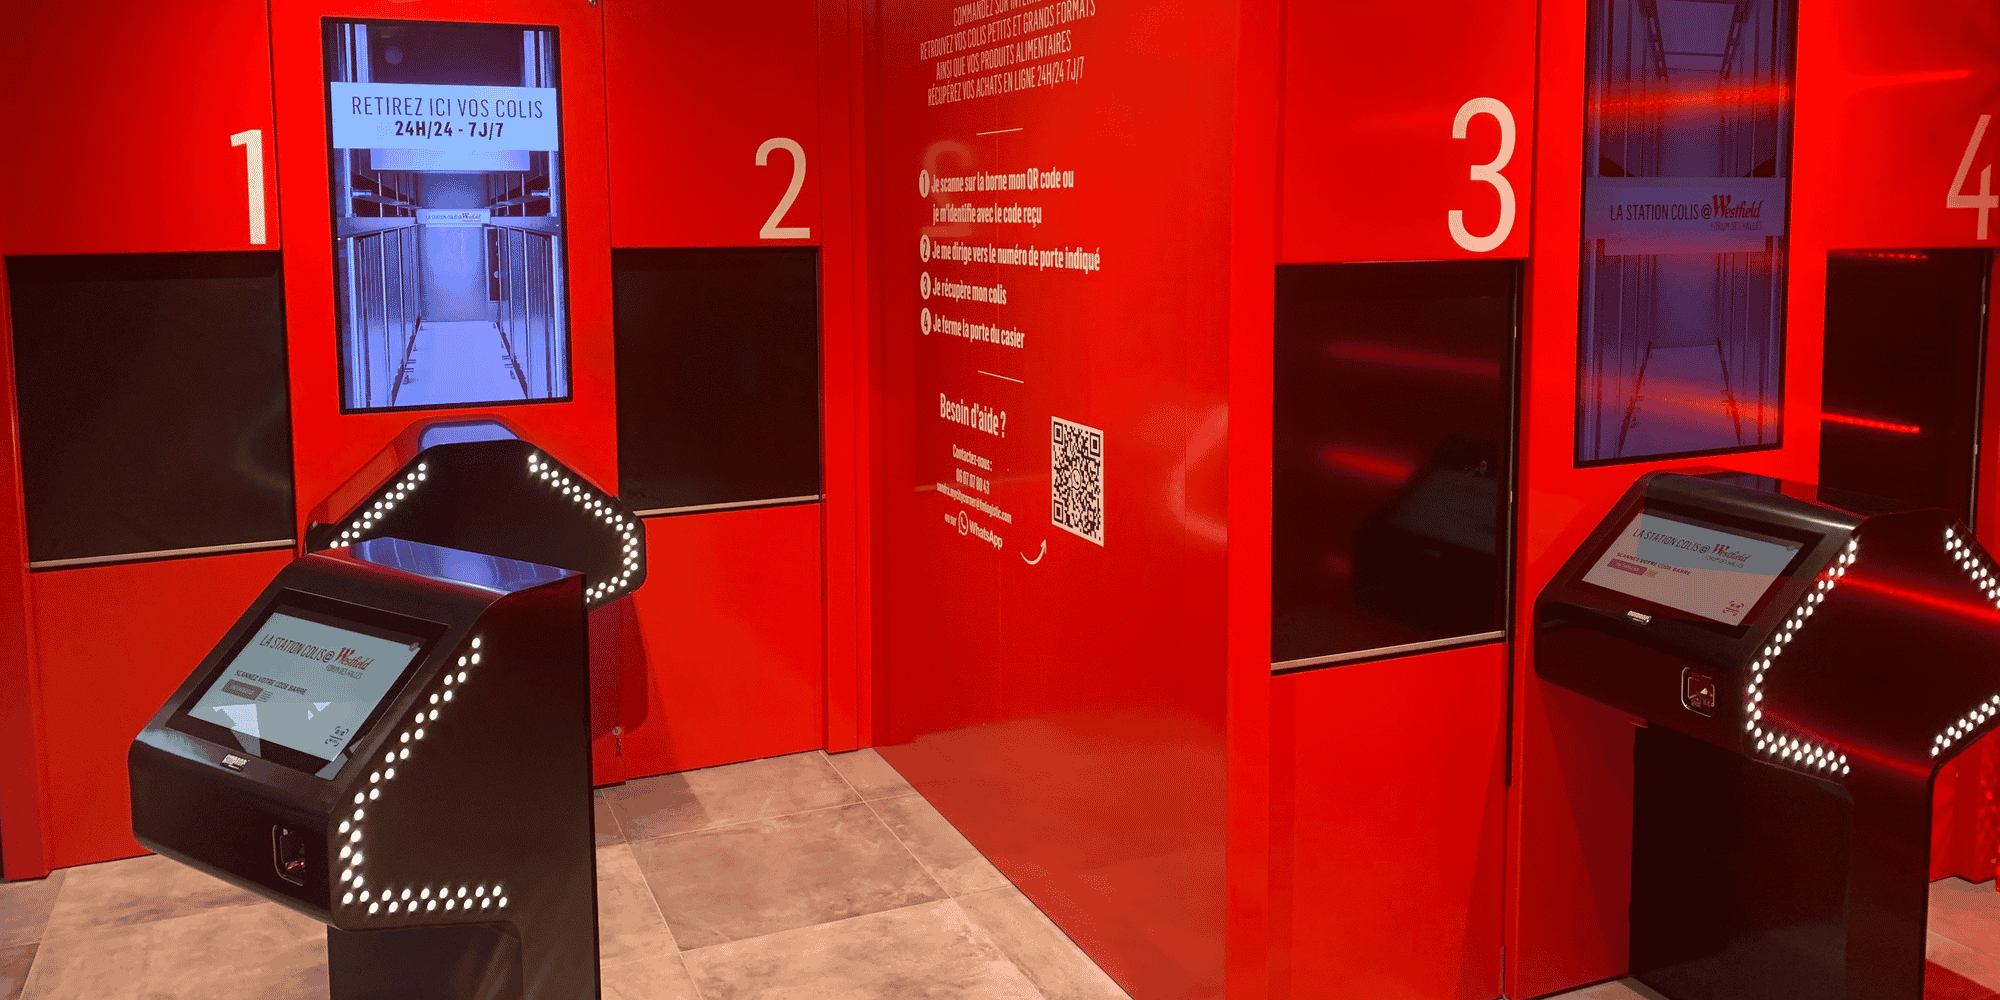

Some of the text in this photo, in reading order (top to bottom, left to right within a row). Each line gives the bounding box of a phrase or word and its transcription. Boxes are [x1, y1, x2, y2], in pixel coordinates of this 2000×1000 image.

[920, 0, 1096, 60] RETROUVEZ VOS COLIS PETITS ET GRANDS FORMATS
[936, 29, 1072, 81] AINSI QUE VOS PRODUITS ALIMENTAIRES
[962, 79, 975, 100] VOS
[976, 71, 1003, 97] ACHATS
[1004, 70, 1013, 92] EN
[1014, 66, 1036, 91] LIGNE
[1037, 60, 1064, 89] 24H/24
[1066, 56, 1085, 84] 7J/7
[352, 96, 543, 119] RETIREZ ICI VOS COLIS
[394, 121, 453, 139] 24H/24
[468, 122, 504, 140] 7J/7
[230, 129, 267, 245] 1
[755, 137, 811, 240] 2
[931, 174, 939, 193] Je
[940, 177, 964, 192] scanne
[965, 176, 976, 192] sur
[977, 171, 985, 191] la
[985, 171, 1007, 191] borne
[1008, 173, 1026, 190] mon
[1027, 167, 1039, 191] QR
[1040, 167, 1062, 189] code
[1063, 170, 1075, 188] ou
[1447, 97, 1516, 253] 3
[1946, 114, 2000, 241] 4
[932, 203, 939, 226] je
[976, 207, 994, 223] avec
[995, 203, 1003, 223] le
[1003, 203, 1023, 223] code
[1023, 207, 1042, 228] reçu
[1610, 204, 1623, 221] LA
[1626, 204, 1669, 221] STATION
[1671, 203, 1699, 220] COLIS
[932, 241, 941, 259] Je
[941, 244, 952, 260] me
[952, 242, 972, 265] dirige
[972, 247, 988, 262] vers
[989, 243, 997, 263] le
[998, 244, 1028, 265] numéro
[1028, 245, 1039, 266] de
[1040, 248, 1064, 271] porte
[1065, 247, 1100, 275] indiqué
[933, 278, 941, 296] Je
[941, 278, 971, 302] récupère
[972, 286, 988, 302] mon
[988, 284, 1007, 305] colis
[933, 314, 941, 333] Je
[942, 315, 962, 336] ferme
[962, 319, 970, 338] la
[970, 323, 989, 342] porte
[990, 324, 1000, 344] du
[1001, 327, 1025, 348] casier
[940, 392, 1007, 438] Besoin d'aide ?
[969, 519, 1003, 550] WhatsApp
[1633, 528, 1647, 538] LA
[1643, 531, 1676, 546] STATION
[259, 634, 275, 648] LA
[269, 636, 304, 655] STATION
